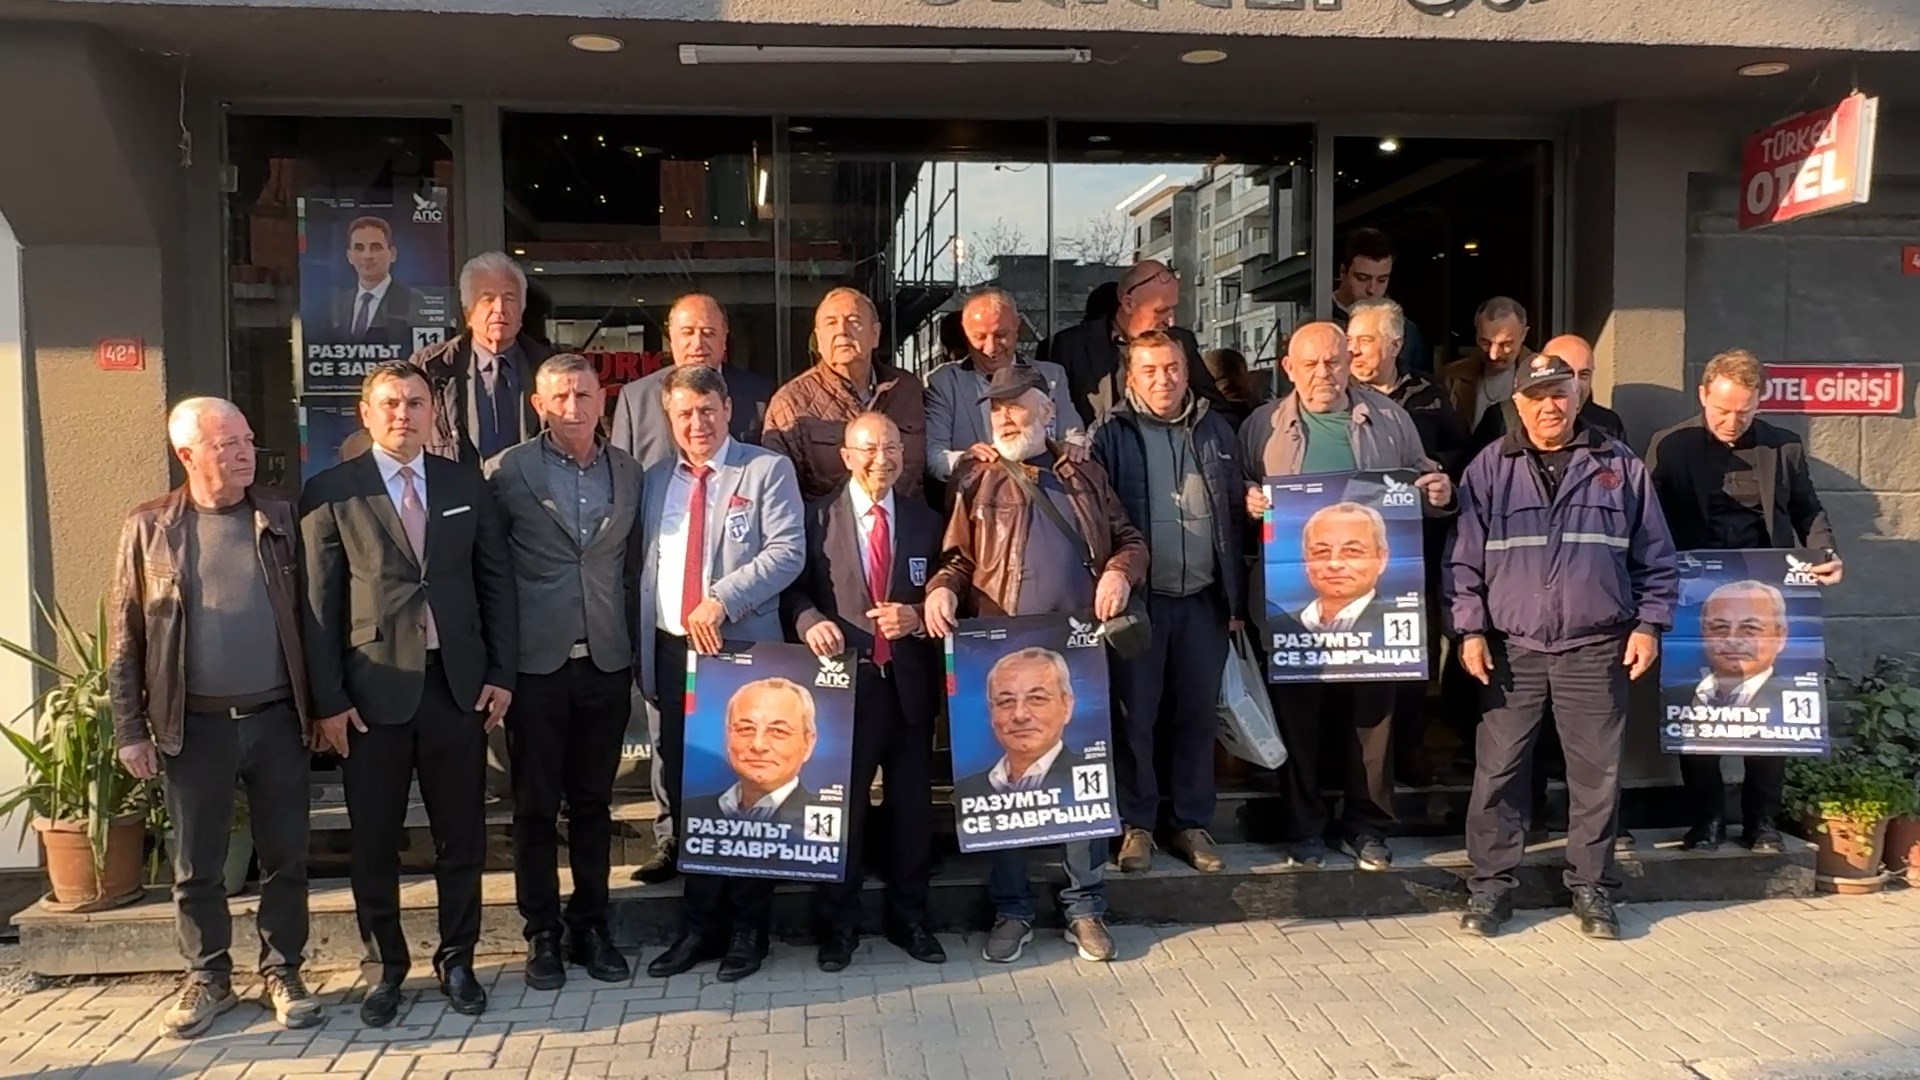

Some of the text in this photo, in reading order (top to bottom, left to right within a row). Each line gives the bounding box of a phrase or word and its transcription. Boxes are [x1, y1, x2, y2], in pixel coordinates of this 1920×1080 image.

[1747, 149, 1847, 214] OTEL
[412, 210, 442, 221] АПС
[308, 344, 401, 359] РАЗУМЪТ
[309, 361, 334, 376] СЕ
[1815, 372, 1892, 407] GİRİŞİ
[1382, 493, 1414, 505] АПС
[1784, 573, 1818, 585] АПС
[1066, 632, 1099, 646] АПС
[1390, 619, 1411, 641] 11
[1272, 632, 1372, 648] РАЗУМЪТ
[1273, 649, 1421, 666] СЕ ЗАВРЪЩА!
[815, 672, 850, 686] АПС
[1666, 705, 1770, 722] РАЗУМЪТ
[1789, 697, 1811, 718] 11
[1666, 723, 1821, 741] СЕ ЗАВРЪЩА!
[1079, 770, 1101, 795] 11
[961, 788, 1061, 814] РАЗУМЪТ
[811, 812, 834, 837] 11
[963, 802, 1112, 834] СЕ ЗАВРЪЩА!
[687, 817, 792, 839] РАЗУМЪТ
[685, 837, 840, 864] СЕ ЗАВРЪЩА!
